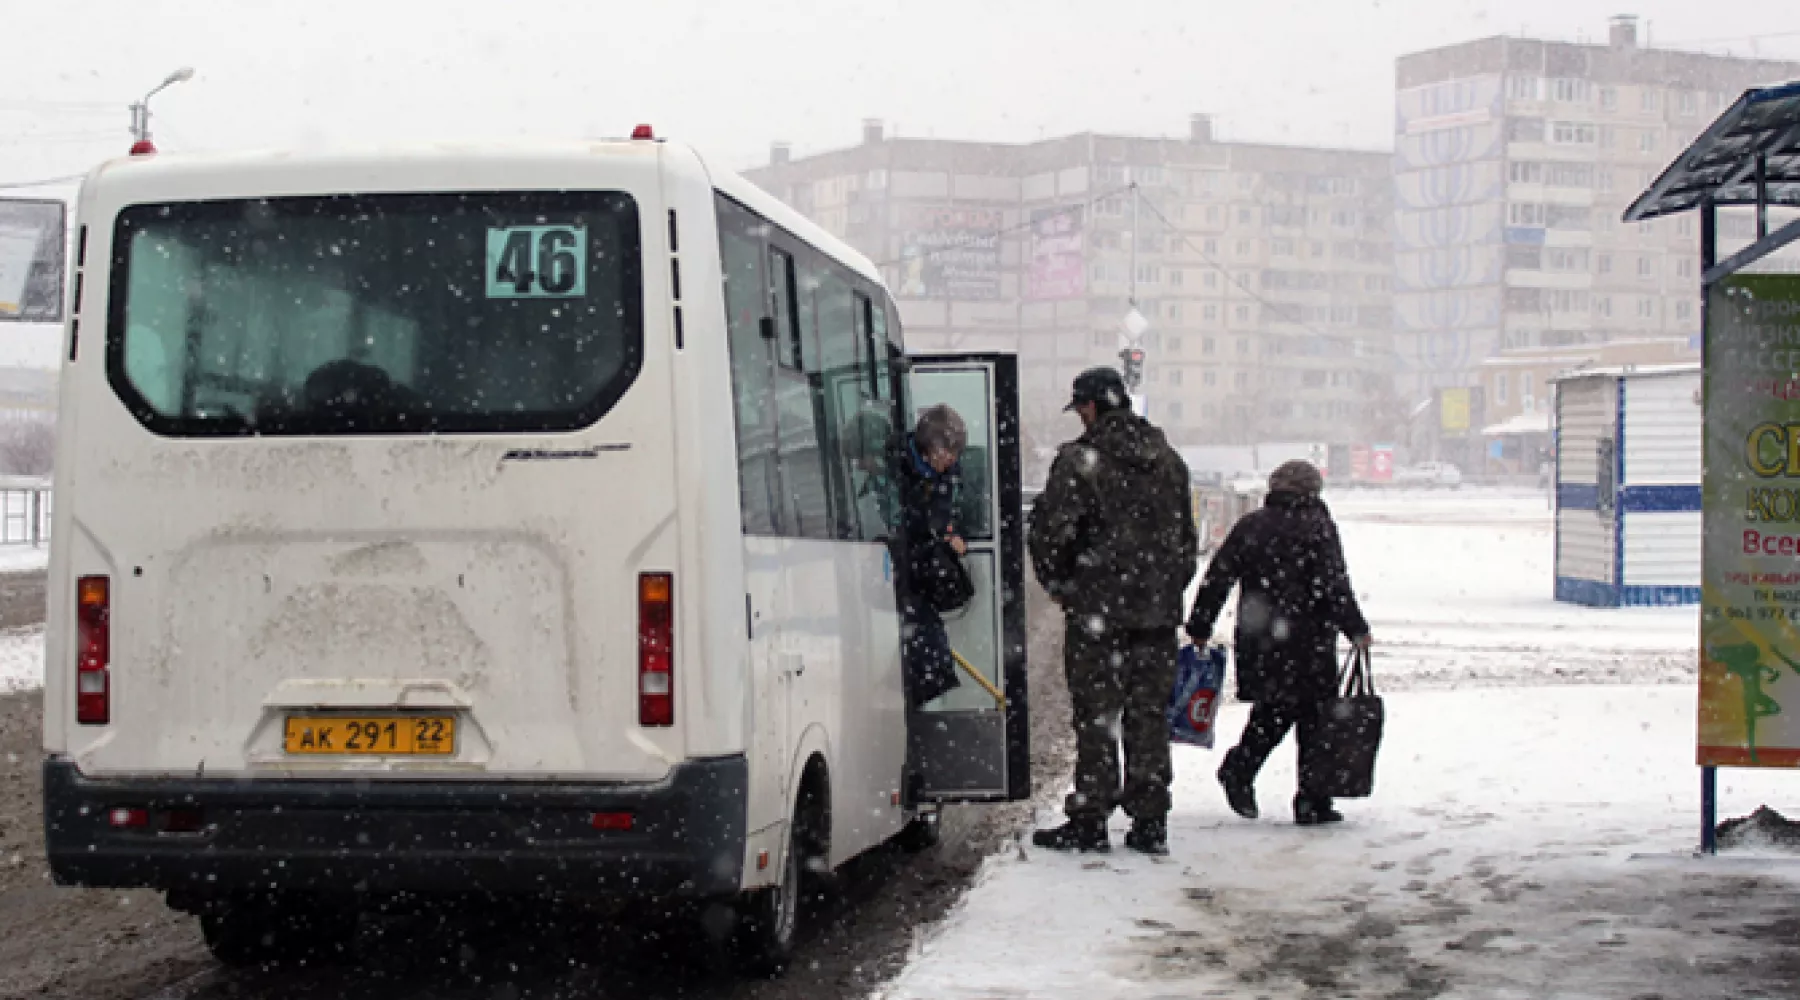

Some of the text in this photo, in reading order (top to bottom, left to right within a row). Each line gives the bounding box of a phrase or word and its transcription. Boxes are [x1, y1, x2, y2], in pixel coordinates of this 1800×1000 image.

[496, 229, 578, 294] 46
[1745, 487, 1800, 523] КО
[346, 721, 398, 749] 291
[416, 718, 444, 741] 22
